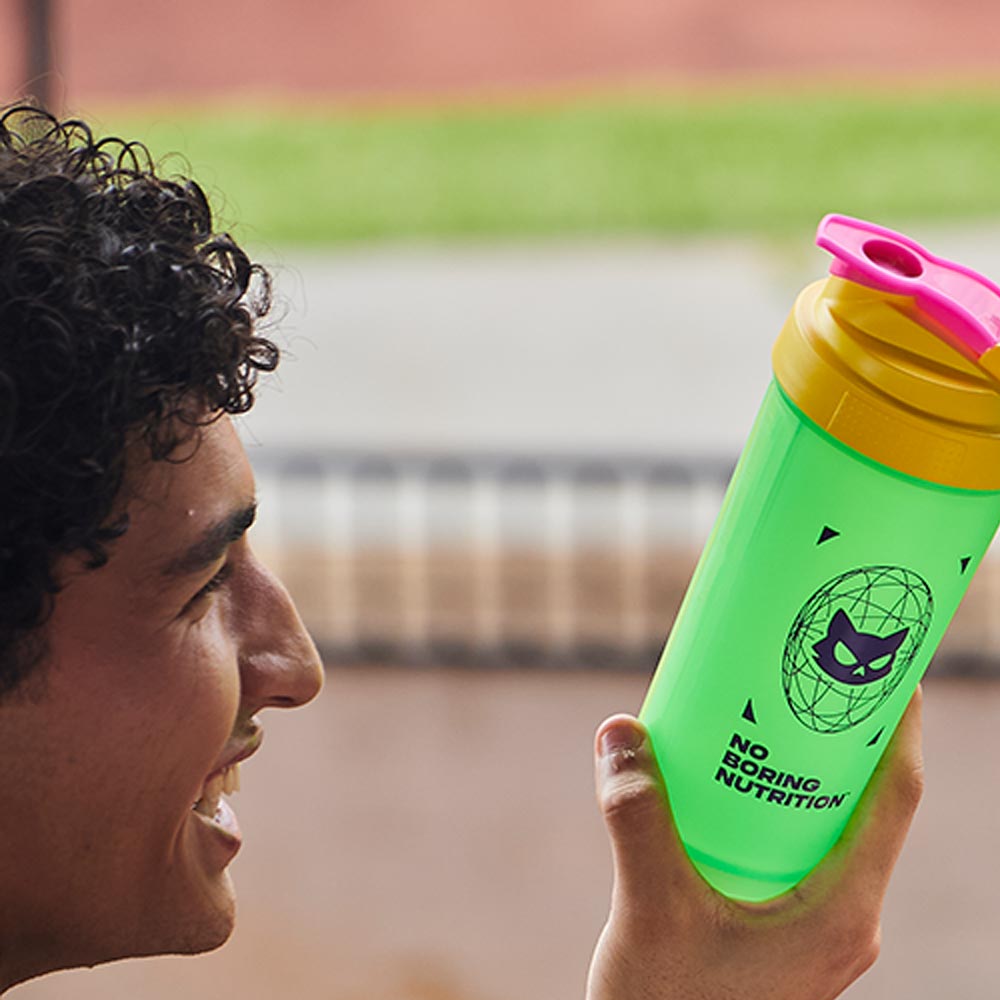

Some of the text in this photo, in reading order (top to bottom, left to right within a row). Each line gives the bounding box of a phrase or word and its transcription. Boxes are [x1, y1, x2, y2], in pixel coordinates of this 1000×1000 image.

[728, 733, 769, 761] NO
[714, 767, 846, 809] NUTRITION
[722, 750, 821, 793] BORING
